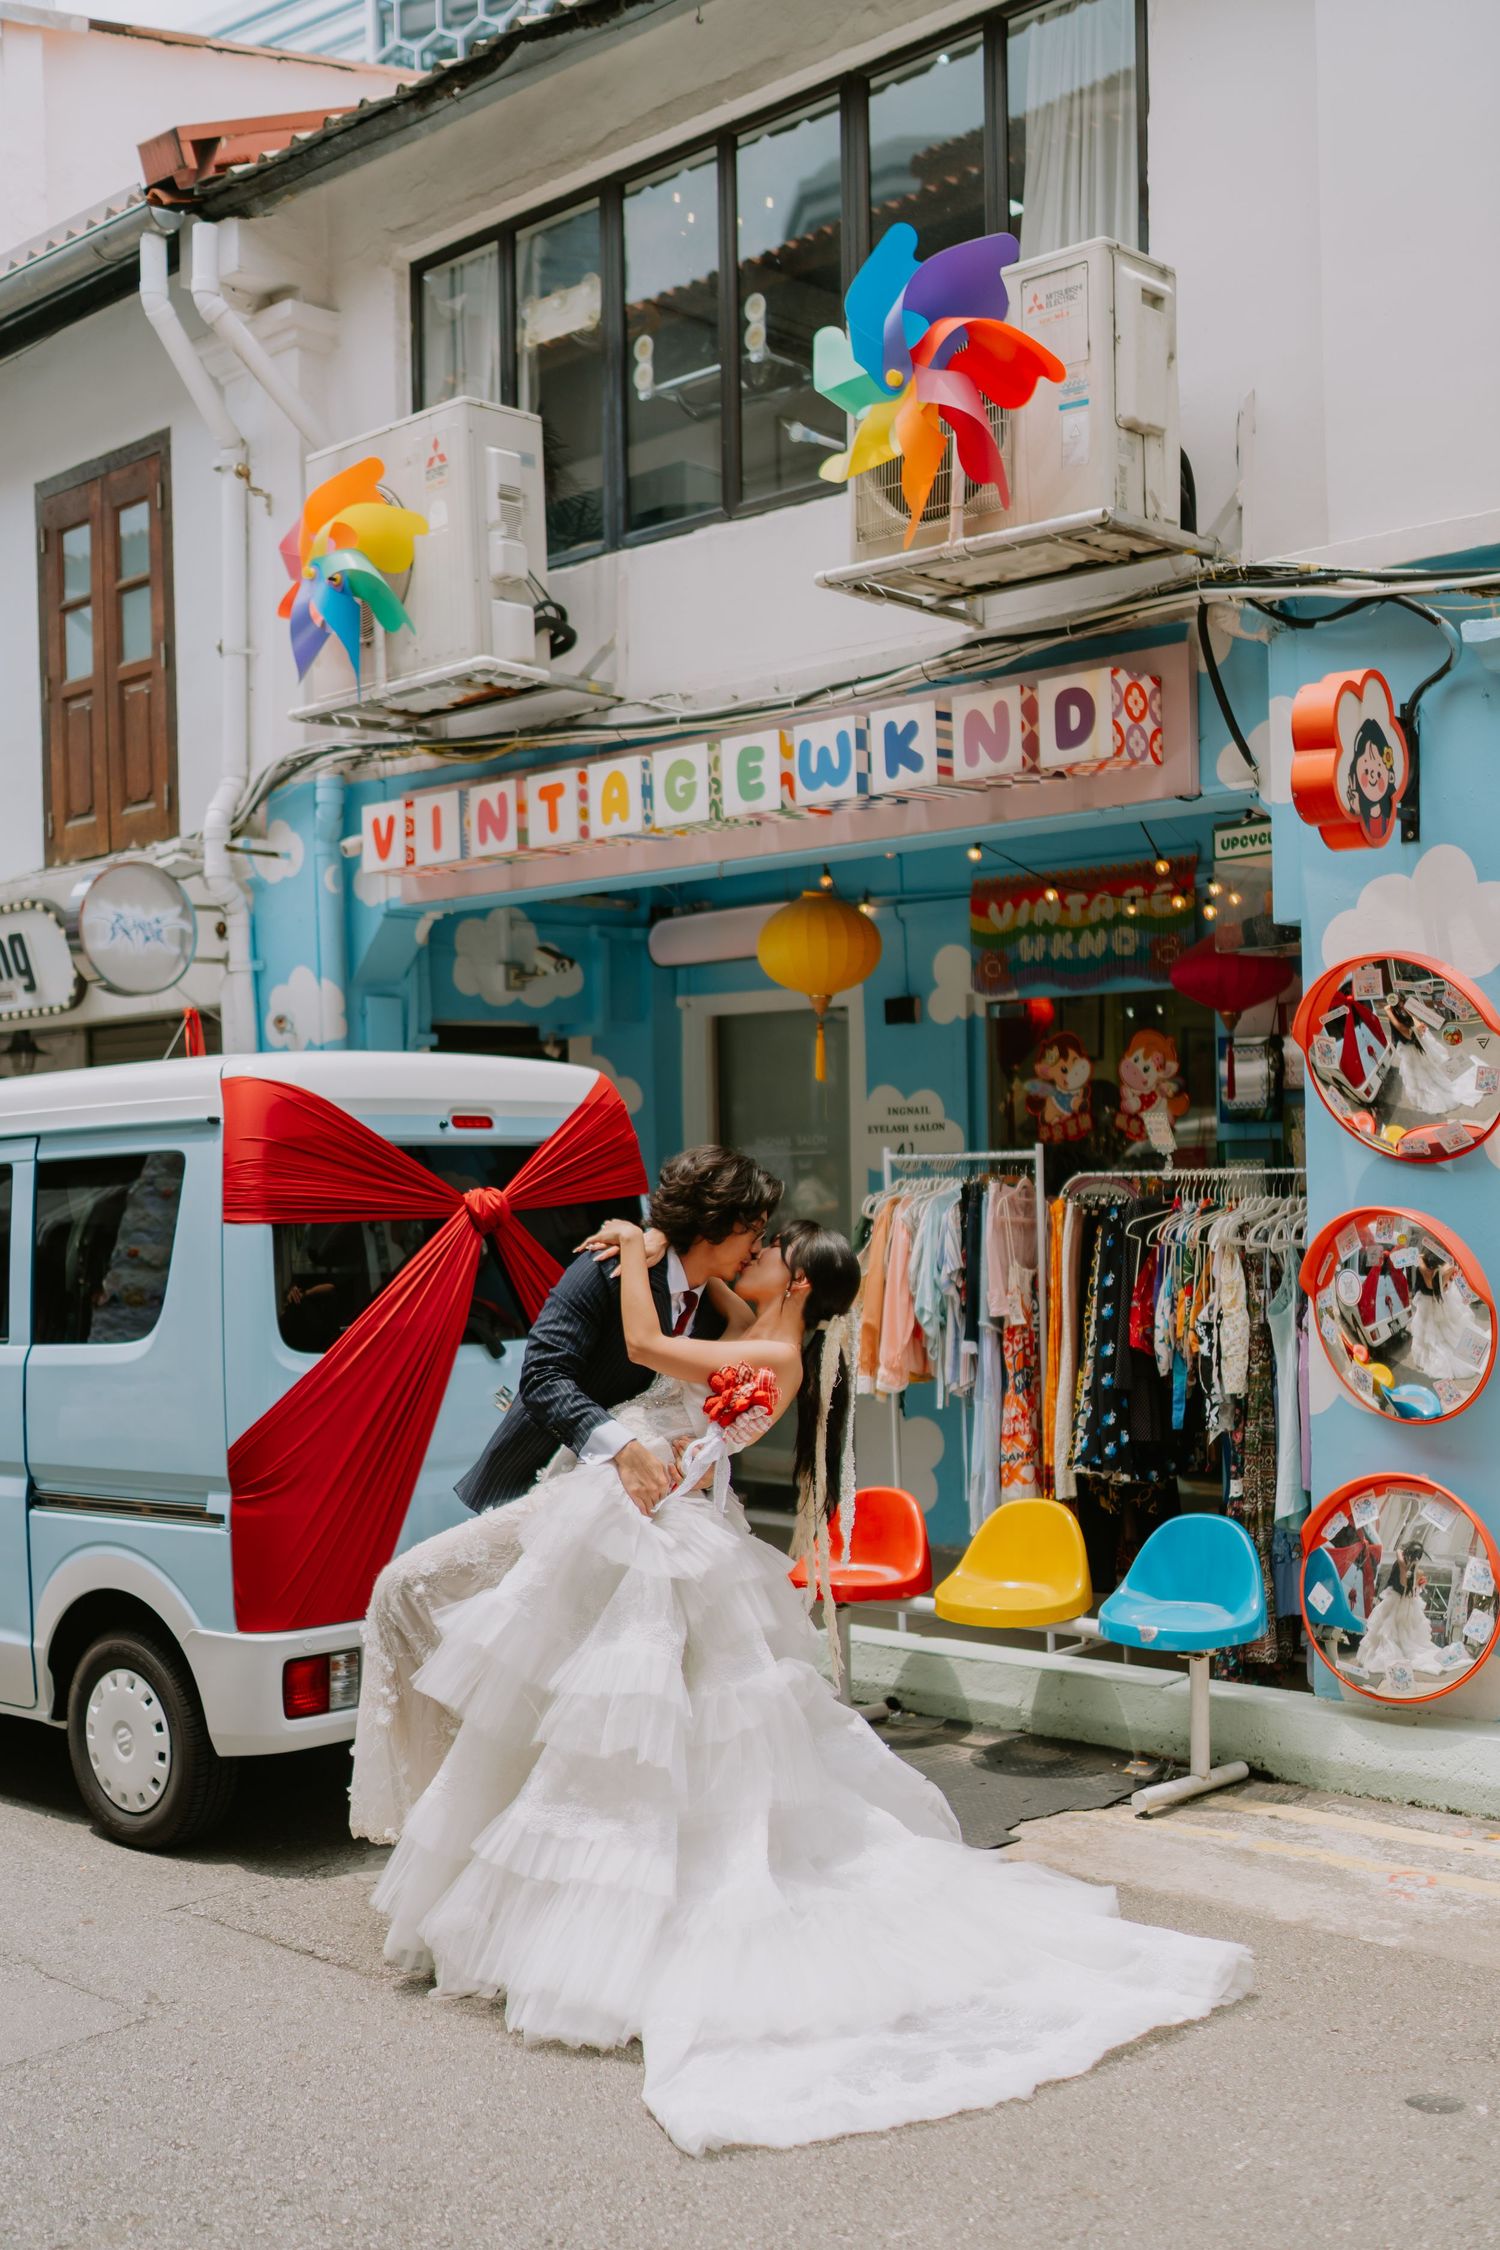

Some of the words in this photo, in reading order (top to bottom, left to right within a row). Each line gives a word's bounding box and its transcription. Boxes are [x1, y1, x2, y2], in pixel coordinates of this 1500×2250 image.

[988, 882, 1175, 929] VINTAGE
[1019, 926, 1139, 962] WKND
[887, 1105, 930, 1116] INGNAIL
[867, 1124, 909, 1134] EYELASH
[914, 1122, 945, 1132] SALON
